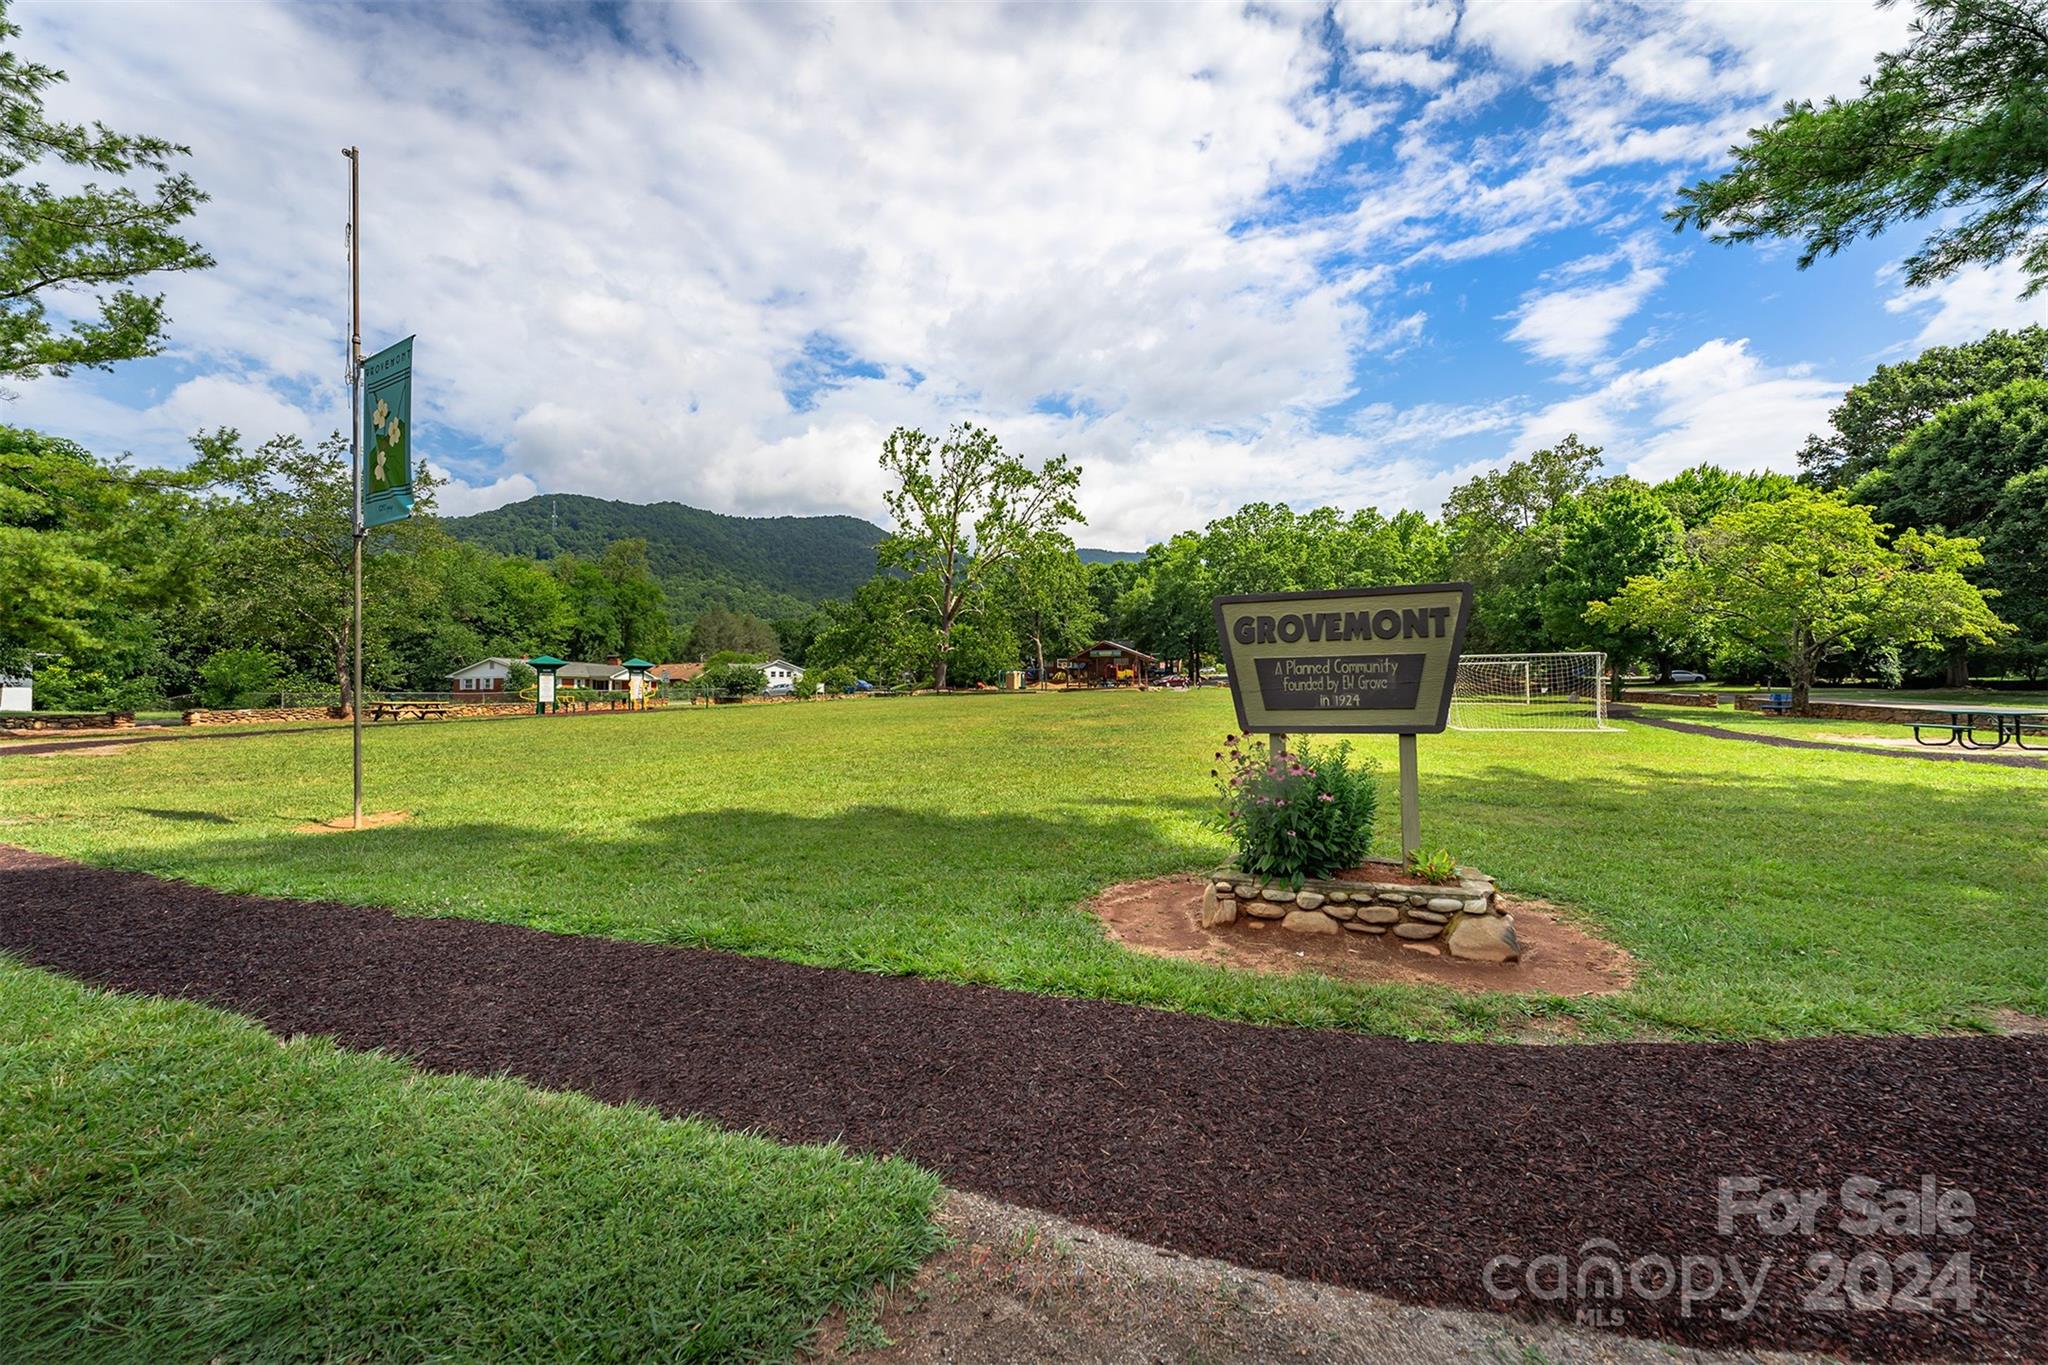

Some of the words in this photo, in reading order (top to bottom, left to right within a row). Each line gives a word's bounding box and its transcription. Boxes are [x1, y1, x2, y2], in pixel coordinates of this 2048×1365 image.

[1233, 607, 1450, 644] GROVEMONT
[1274, 661, 1283, 676] A
[1286, 658, 1330, 675] Planned
[1334, 657, 1399, 675] Community
[1326, 674, 1340, 693] by
[1358, 674, 1388, 690] Grove
[1319, 694, 1330, 707] in
[1335, 694, 1361, 707] 1924
